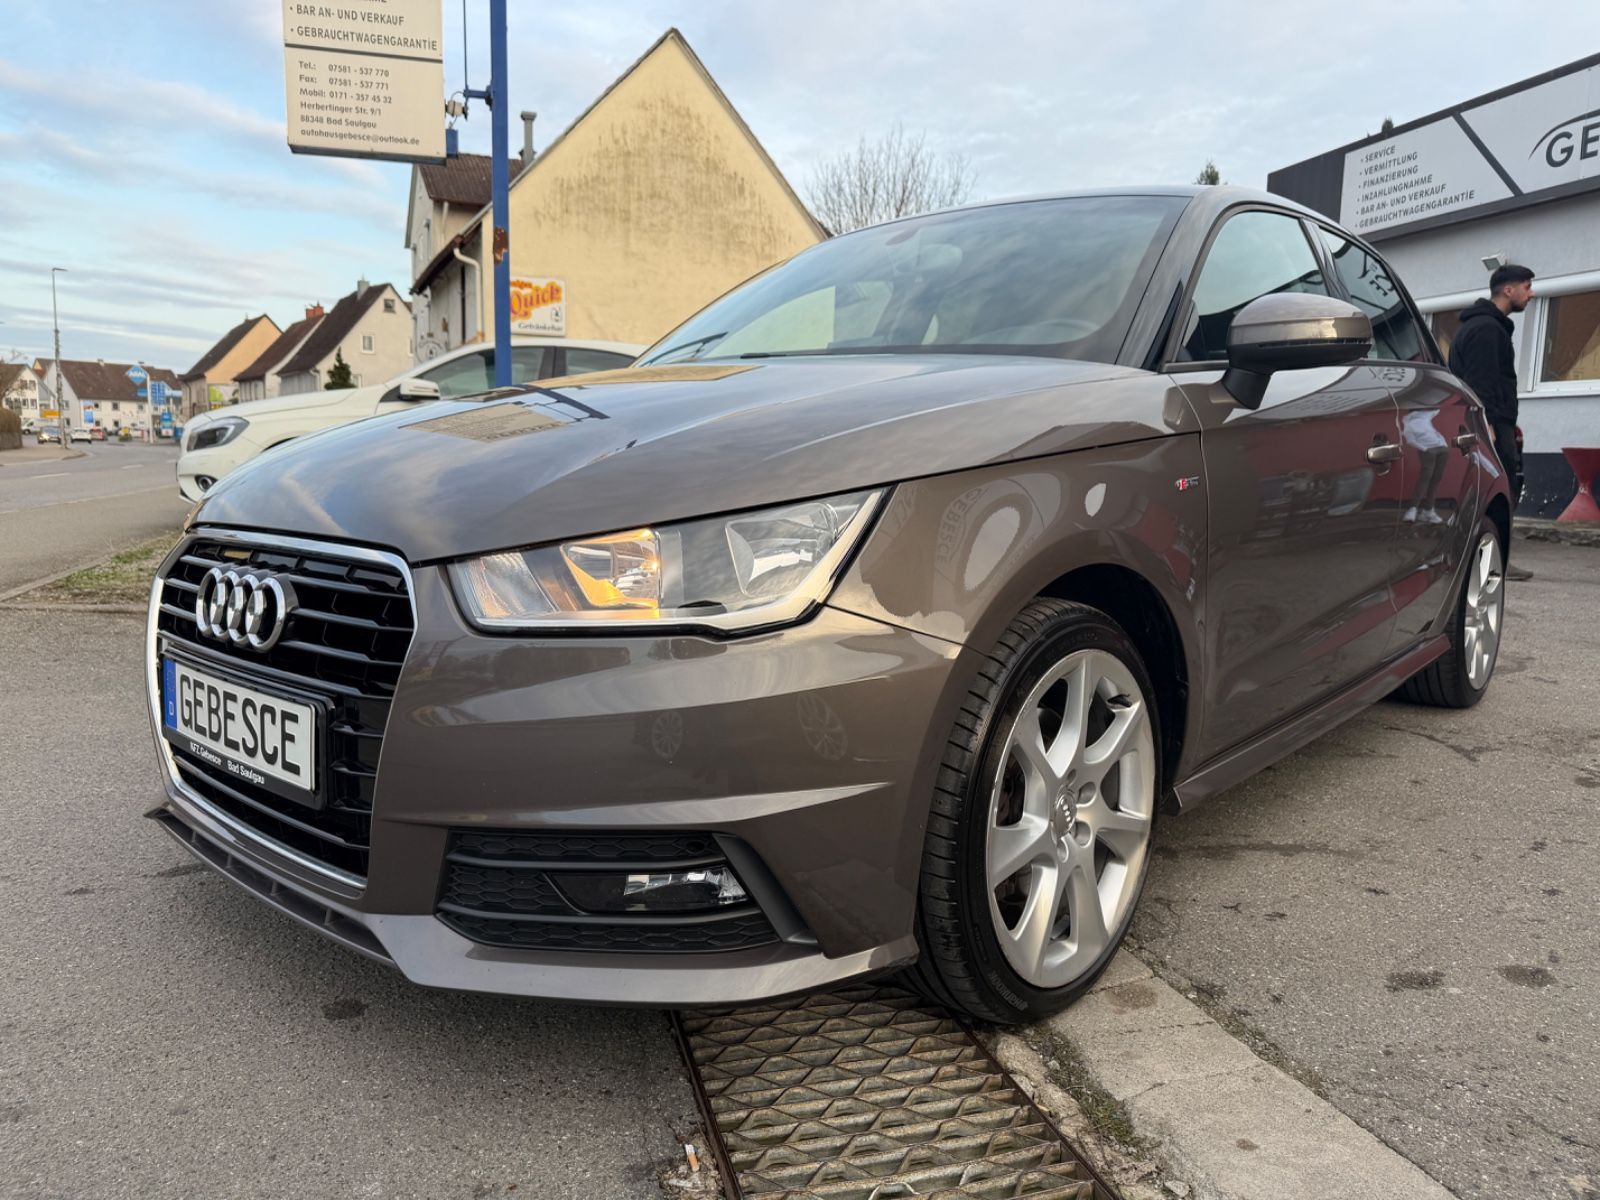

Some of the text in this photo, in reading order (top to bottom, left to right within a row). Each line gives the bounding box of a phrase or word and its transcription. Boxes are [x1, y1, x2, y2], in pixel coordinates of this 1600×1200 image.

[296, 4, 404, 26] BAR AN- UND VERKAUF
[299, 61, 316, 71] Tel.:
[328, 64, 351, 74] 07581
[359, 66, 373, 76] 537
[375, 68, 389, 78] 770
[299, 75, 317, 84] Fax:
[329, 77, 352, 87] 07581
[359, 80, 373, 89] 537
[376, 81, 389, 91] 771
[299, 88, 326, 98] Mobil:
[329, 90, 347, 100] 0171
[356, 93, 369, 102] 357
[382, 95, 392, 104] 32
[300, 102, 382, 116] Herbertinger Str. 9/1
[300, 115, 377, 129] 88348 Bad Saulgau
[300, 128, 420, 146] autohausgebesce@outlook.de
[1360, 204, 1375, 216] BAR
[1390, 195, 1407, 207] UND
[1408, 183, 1447, 201] VERKAUF
[179, 674, 301, 776] GEBESCE
[227, 760, 240, 774] Bad
[240, 766, 265, 785] Saulgau
